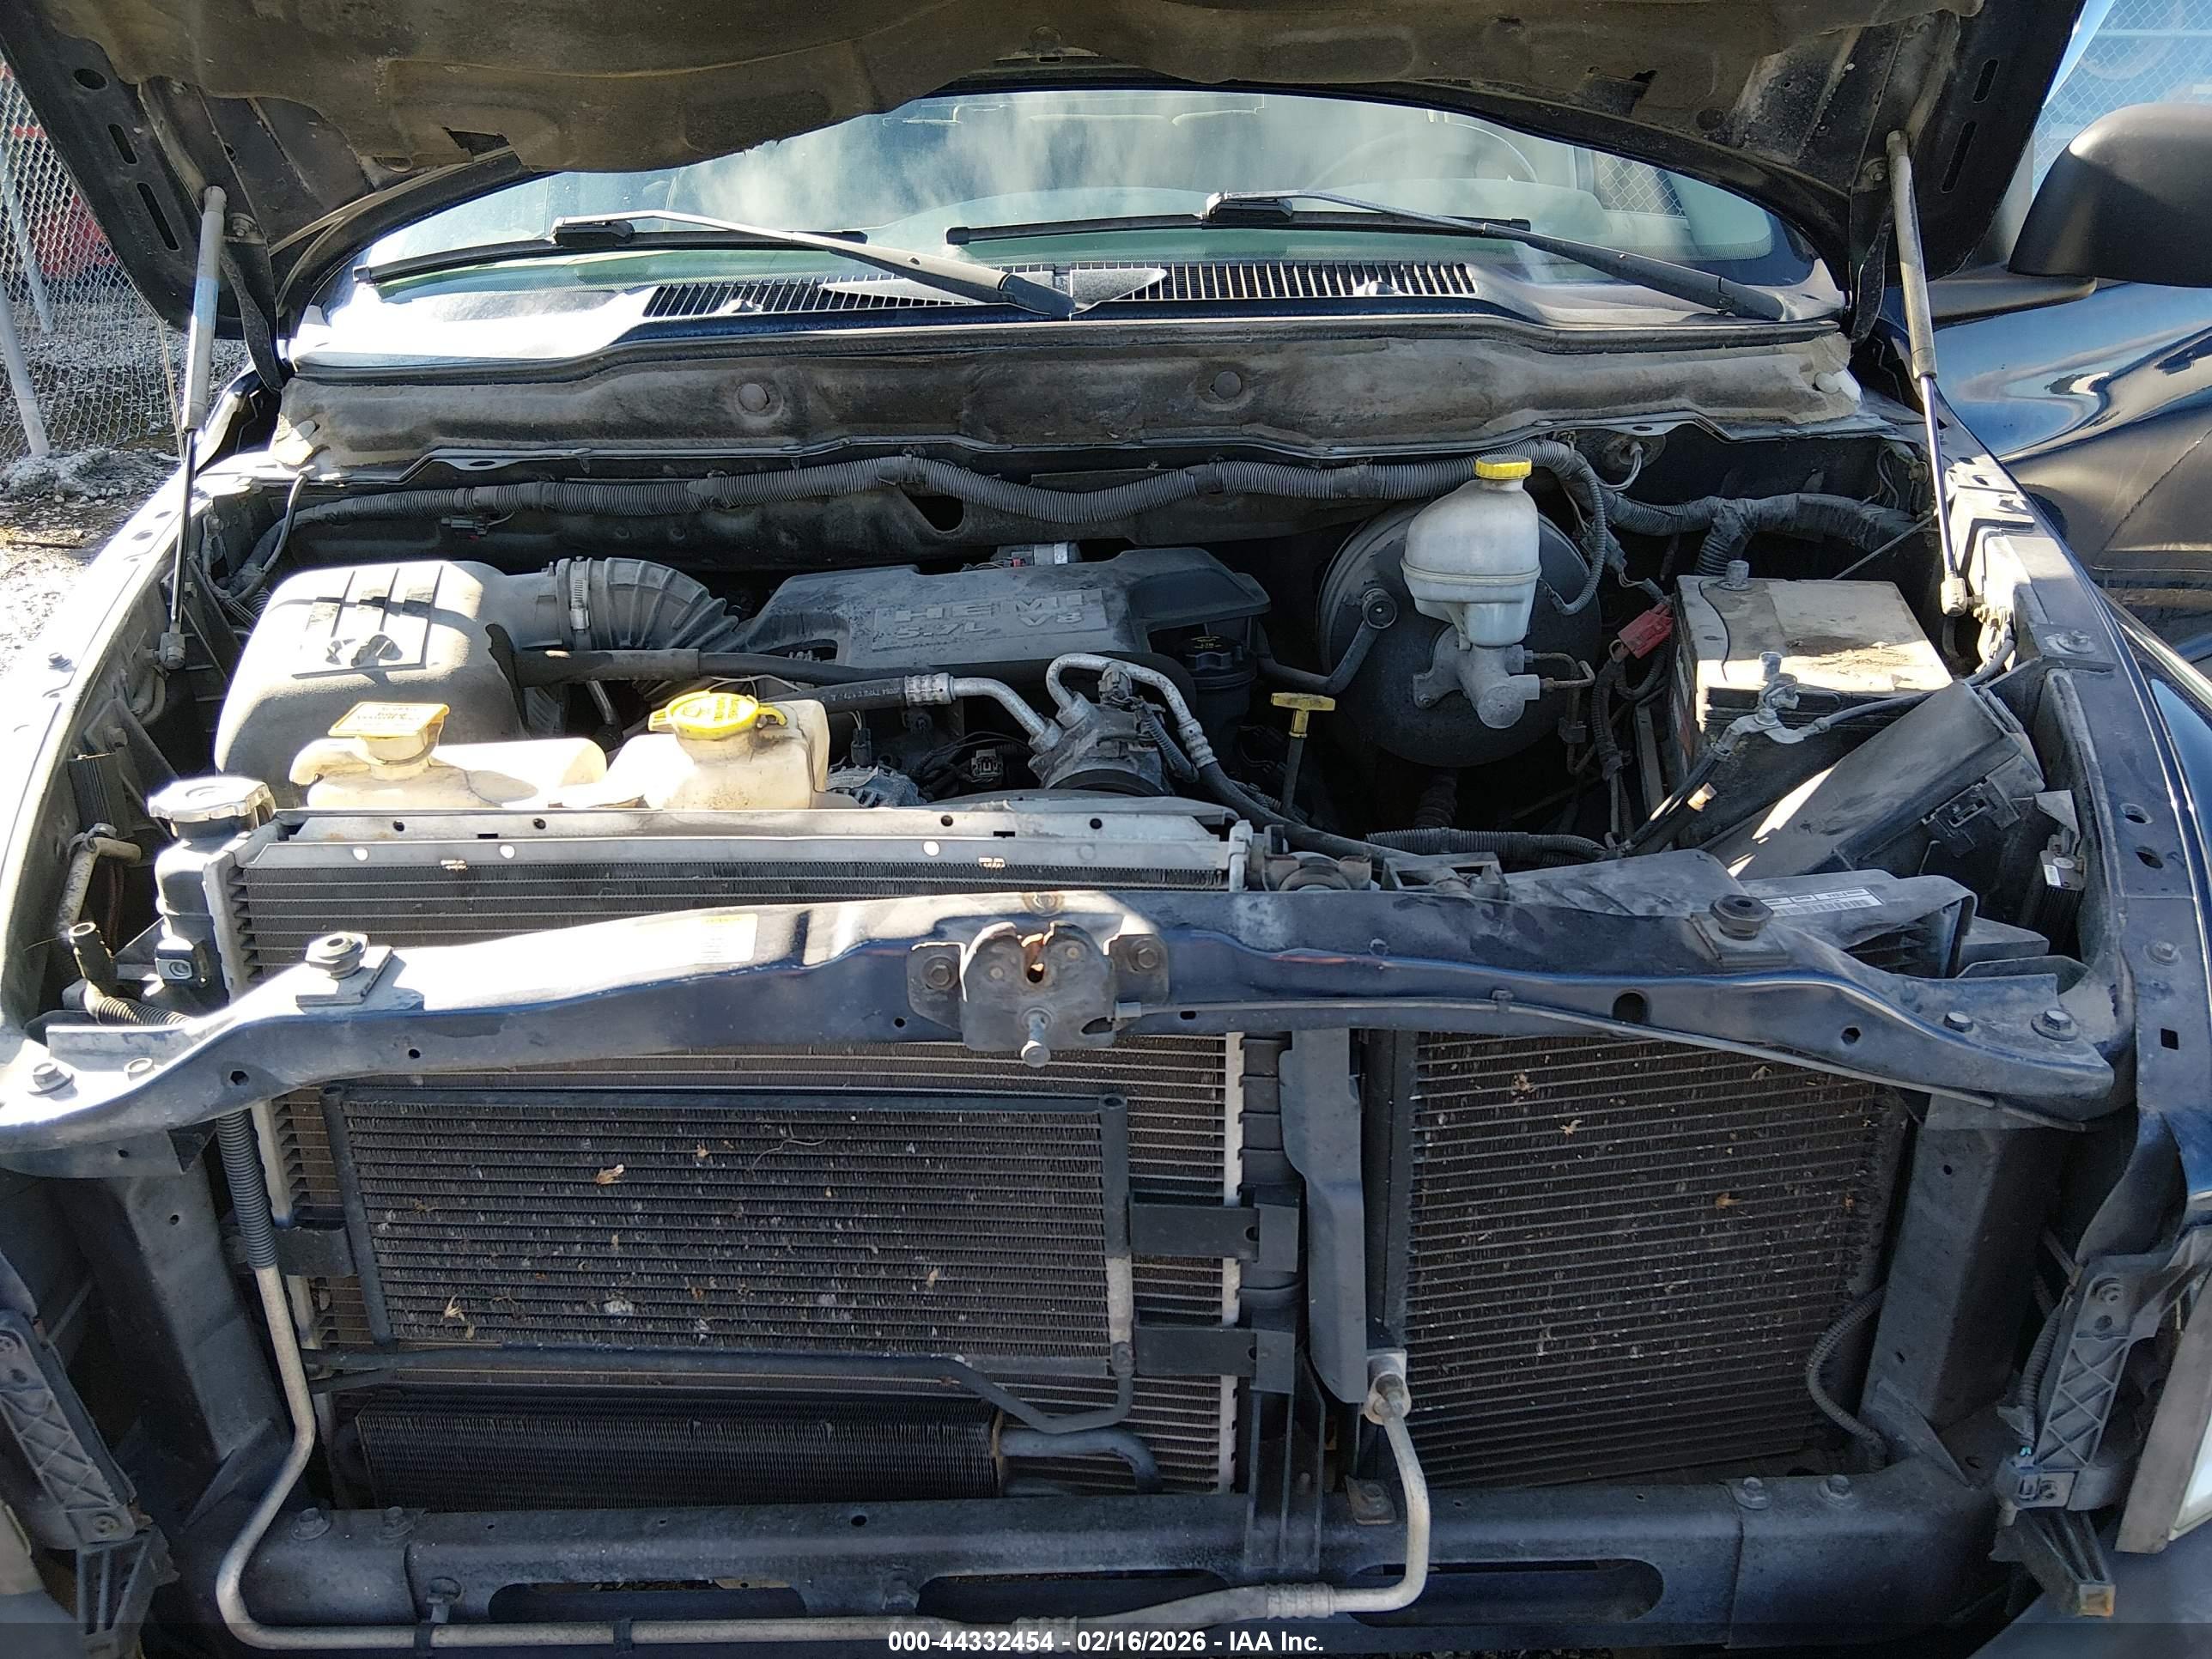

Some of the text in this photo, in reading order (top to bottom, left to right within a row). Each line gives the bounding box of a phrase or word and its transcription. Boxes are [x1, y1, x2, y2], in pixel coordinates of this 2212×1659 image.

[894, 593, 1083, 623] HEMI
[896, 612, 1082, 640] 5.7L V8
